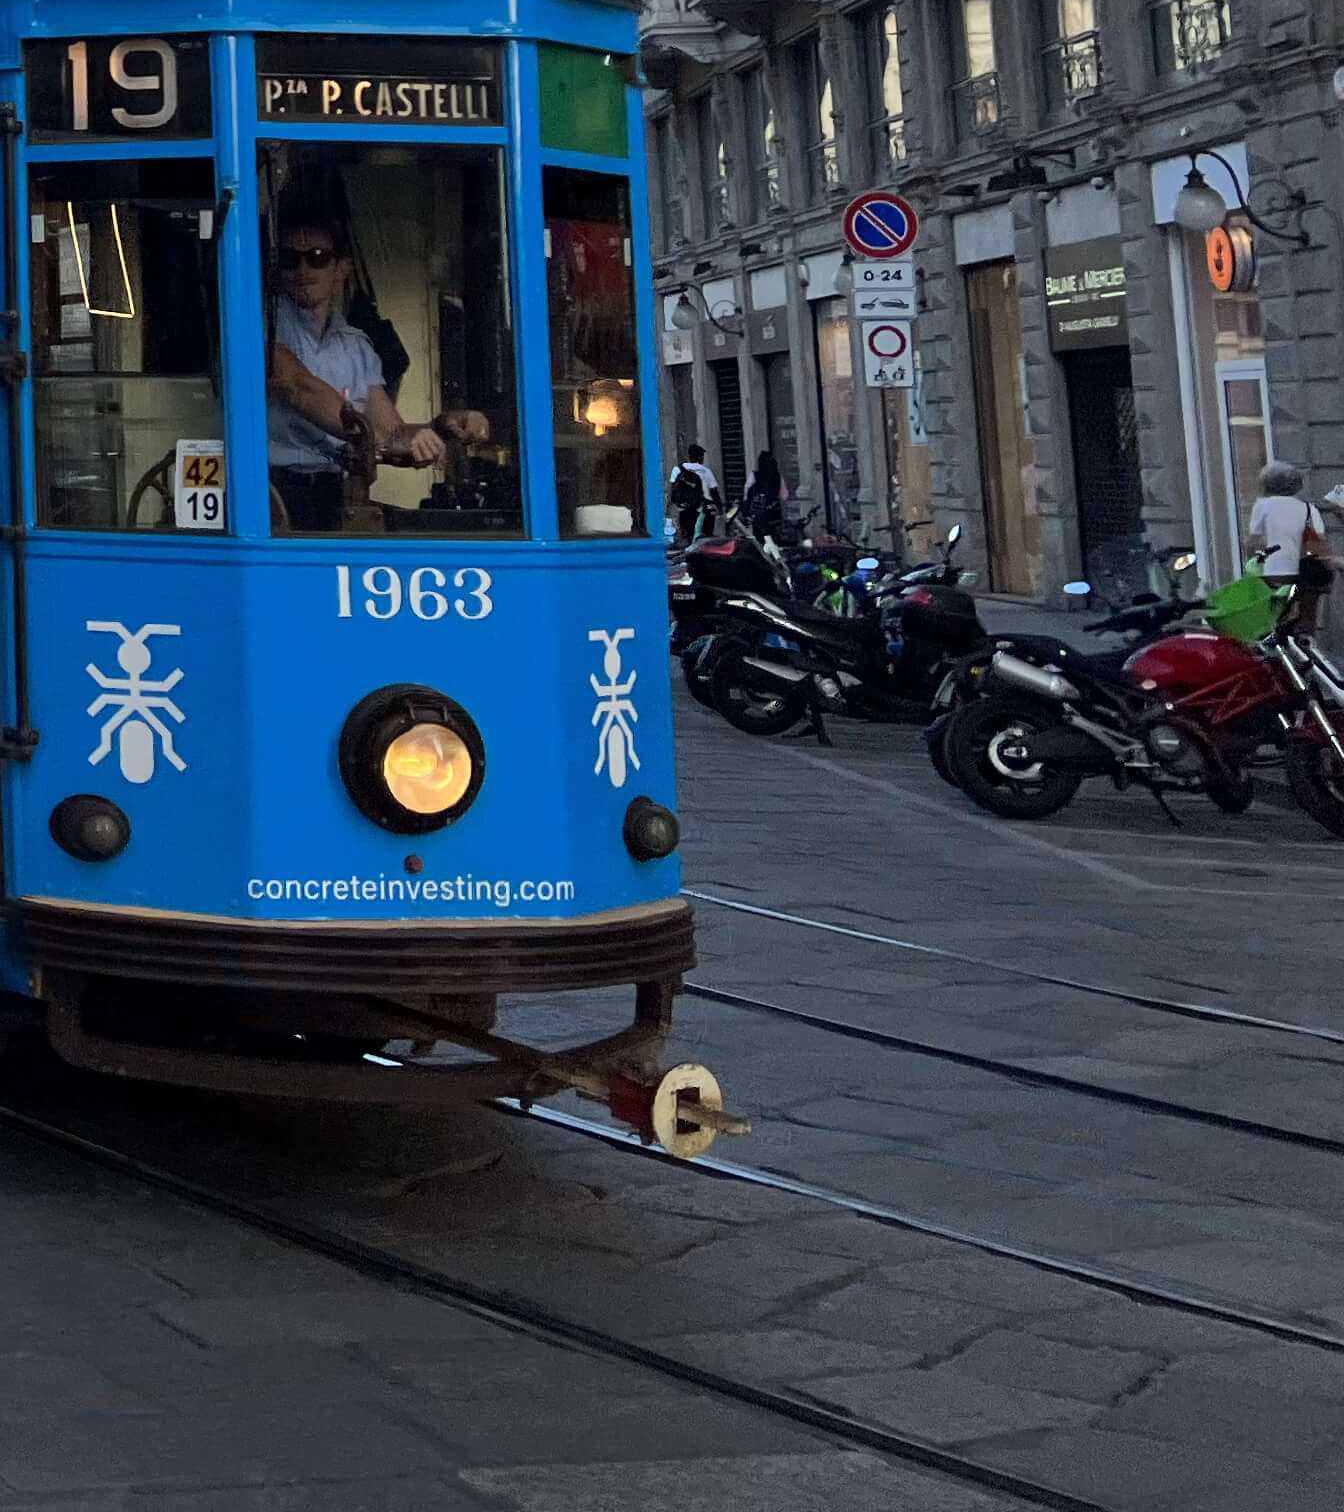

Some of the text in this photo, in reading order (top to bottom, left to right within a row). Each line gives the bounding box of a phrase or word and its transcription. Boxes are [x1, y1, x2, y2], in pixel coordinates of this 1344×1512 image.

[66, 38, 179, 132] 19
[322, 79, 343, 115] P.
[353, 80, 488, 120] CASTELLI
[185, 457, 220, 486] 42
[187, 492, 220, 521] 19
[335, 565, 495, 621] 1963
[247, 873, 576, 907] concreteinvesting.com
